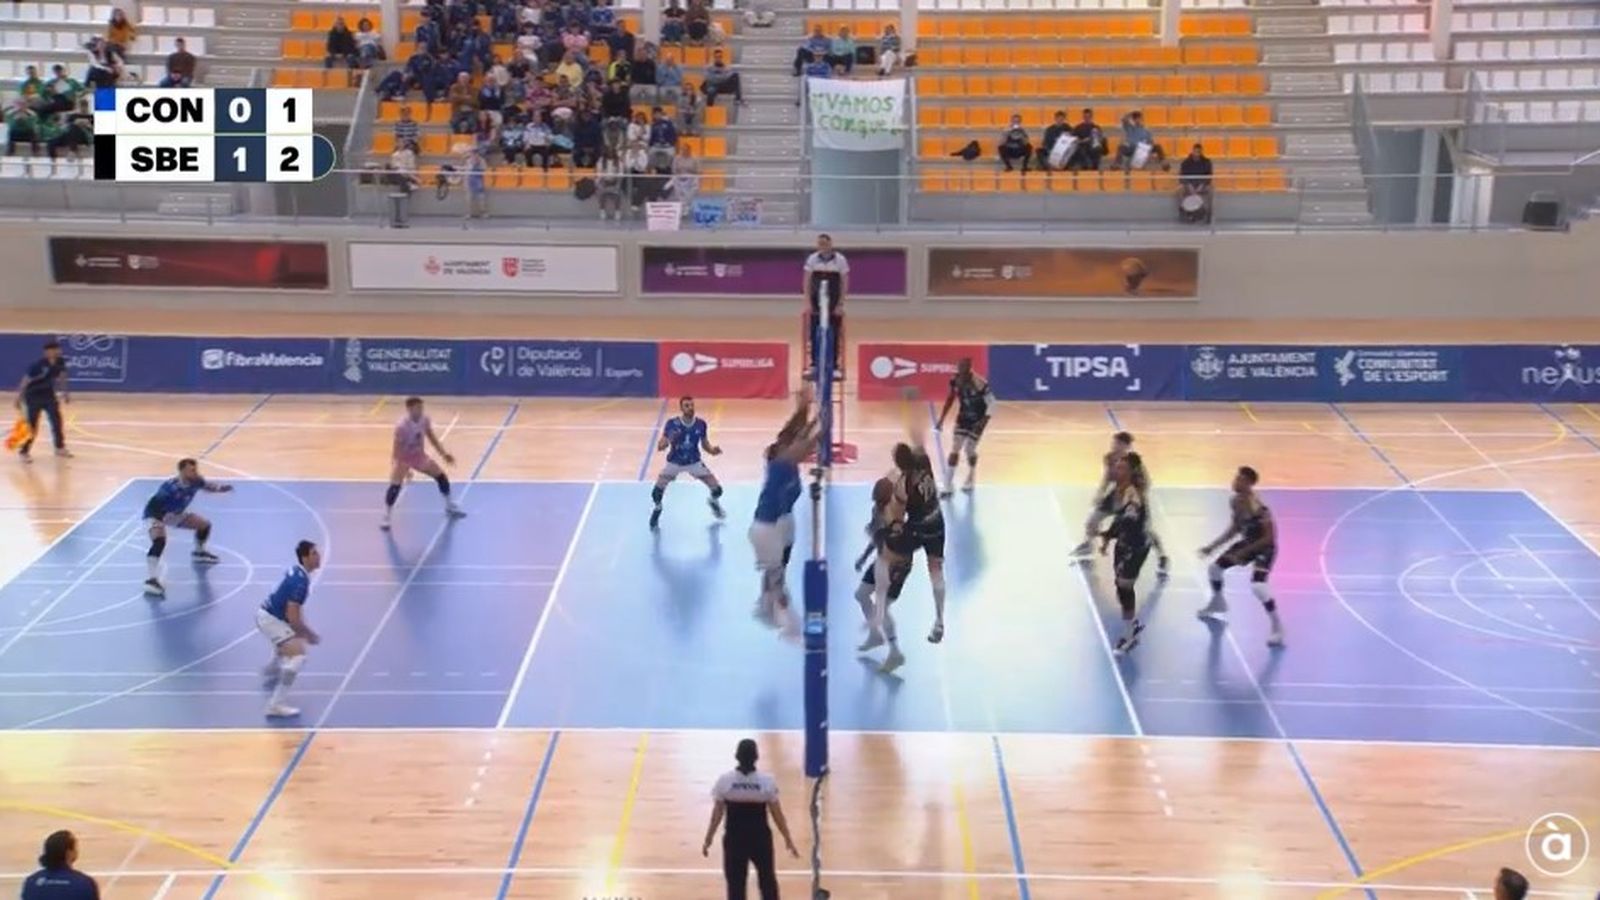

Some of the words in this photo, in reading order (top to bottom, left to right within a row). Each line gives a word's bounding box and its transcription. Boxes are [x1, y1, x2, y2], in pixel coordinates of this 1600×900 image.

[225, 350, 323, 368] FibraValencia
[367, 348, 452, 360] GENERALITAT
[517, 347, 581, 362] Diputació
[1228, 352, 1316, 364] AJUNTAMENT
[367, 361, 450, 373] VALENCIANA
[720, 357, 775, 368] SUPERLIGA
[1046, 357, 1129, 378] TIPSA
[1358, 358, 1437, 370] COMUNITAT
[517, 364, 533, 377] de
[1228, 366, 1246, 378] DE
[1363, 370, 1383, 383] DE
